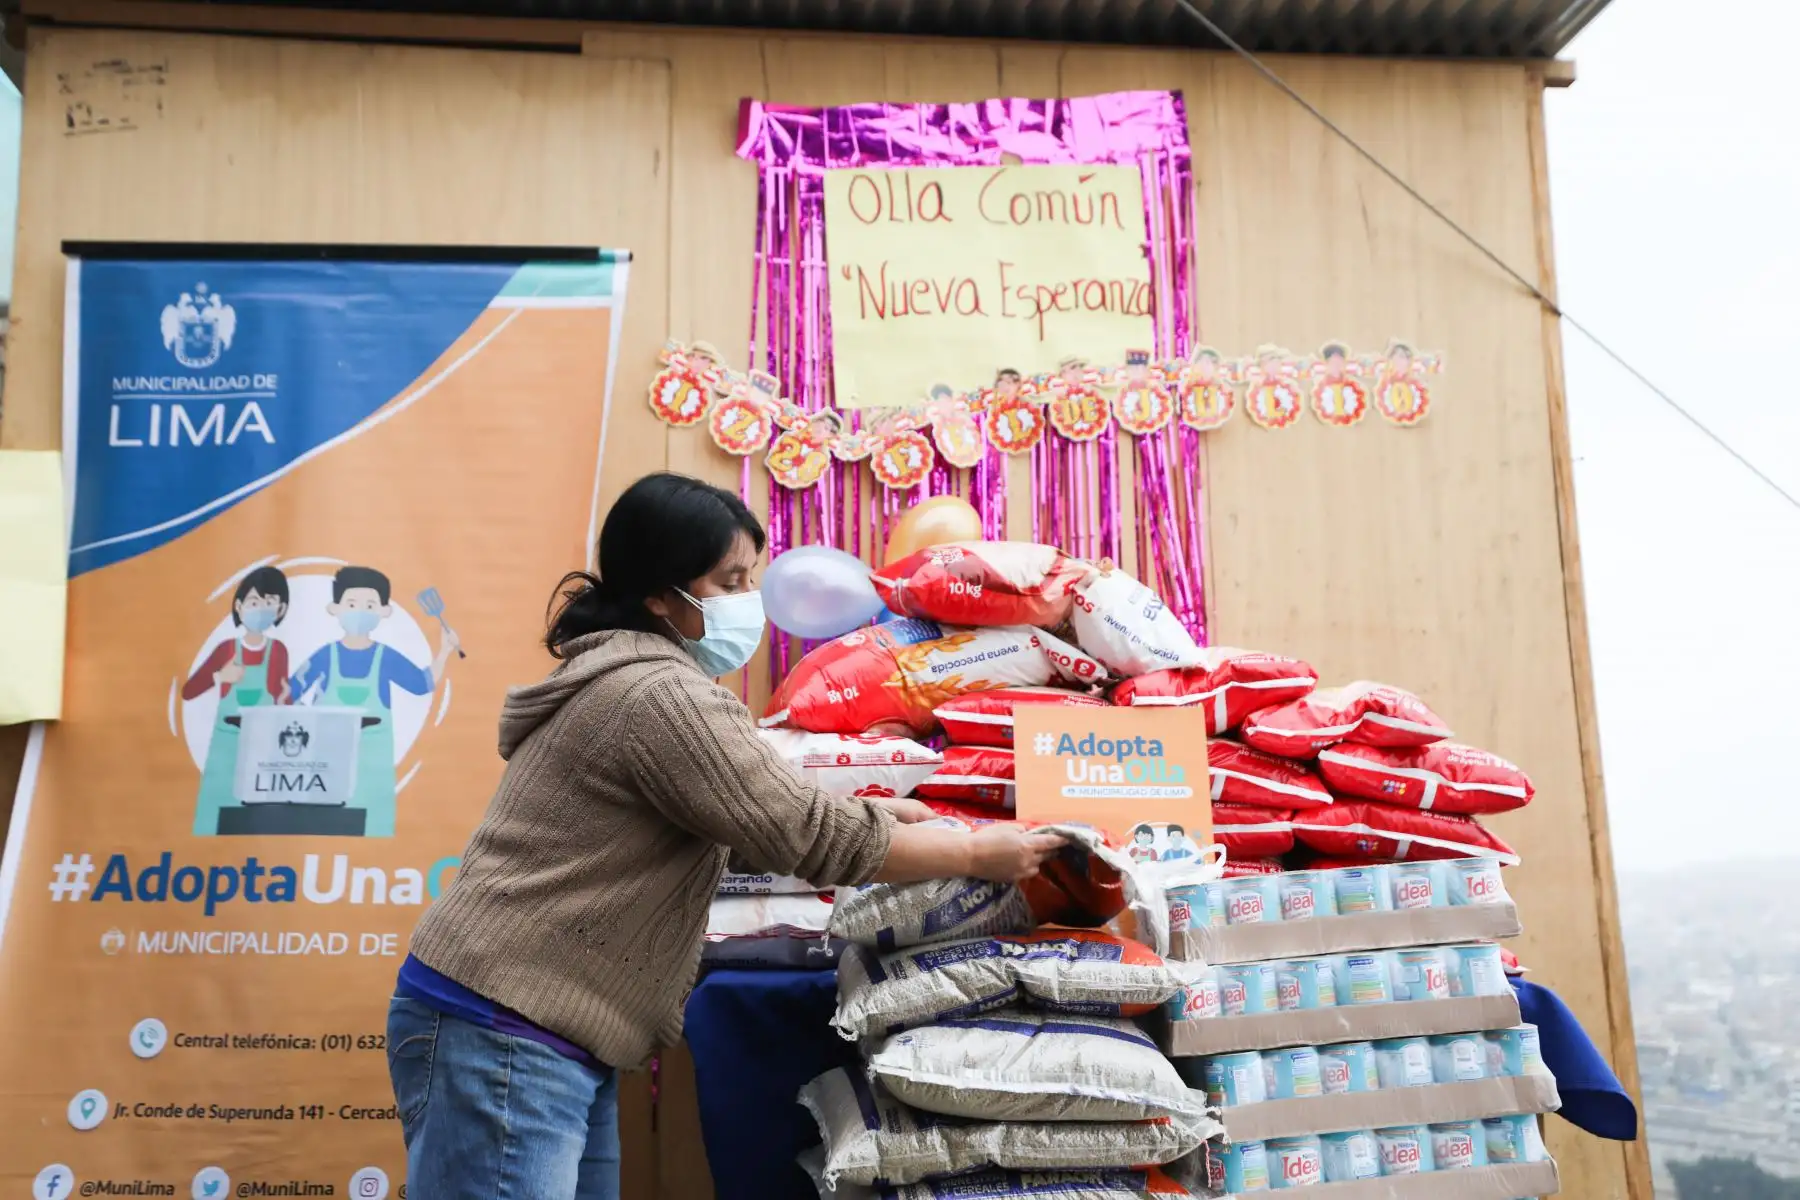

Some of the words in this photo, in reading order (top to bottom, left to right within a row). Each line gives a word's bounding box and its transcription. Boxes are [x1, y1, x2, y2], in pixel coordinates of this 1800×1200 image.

[979, 167, 1125, 230] Común
[112, 375, 249, 391] MUNICIPALIDAD
[253, 374, 278, 389] DE
[109, 400, 276, 447] LIMA
[949, 582, 964, 595] 10
[966, 582, 982, 598] kg
[986, 643, 1019, 659] avena
[931, 654, 986, 675] precocida
[1033, 732, 1164, 763] #Adopta
[1066, 758, 1185, 784] UnaOlla
[255, 773, 327, 792] LIMA
[136, 931, 348, 956] MUNICIPALIDAD
[359, 932, 397, 956] DE
[174, 1033, 228, 1049] Central
[232, 1034, 316, 1050] telefónica:
[321, 1034, 352, 1052] (01)
[357, 1035, 387, 1050] 632
[113, 1103, 129, 1119] Jr.
[134, 1103, 182, 1118] Conde
[187, 1104, 204, 1118] de
[208, 1105, 294, 1125] Superunda
[299, 1105, 324, 1119] 141
[80, 1180, 174, 1197] @MuniLima
[236, 1181, 334, 1198] @MuniLima
